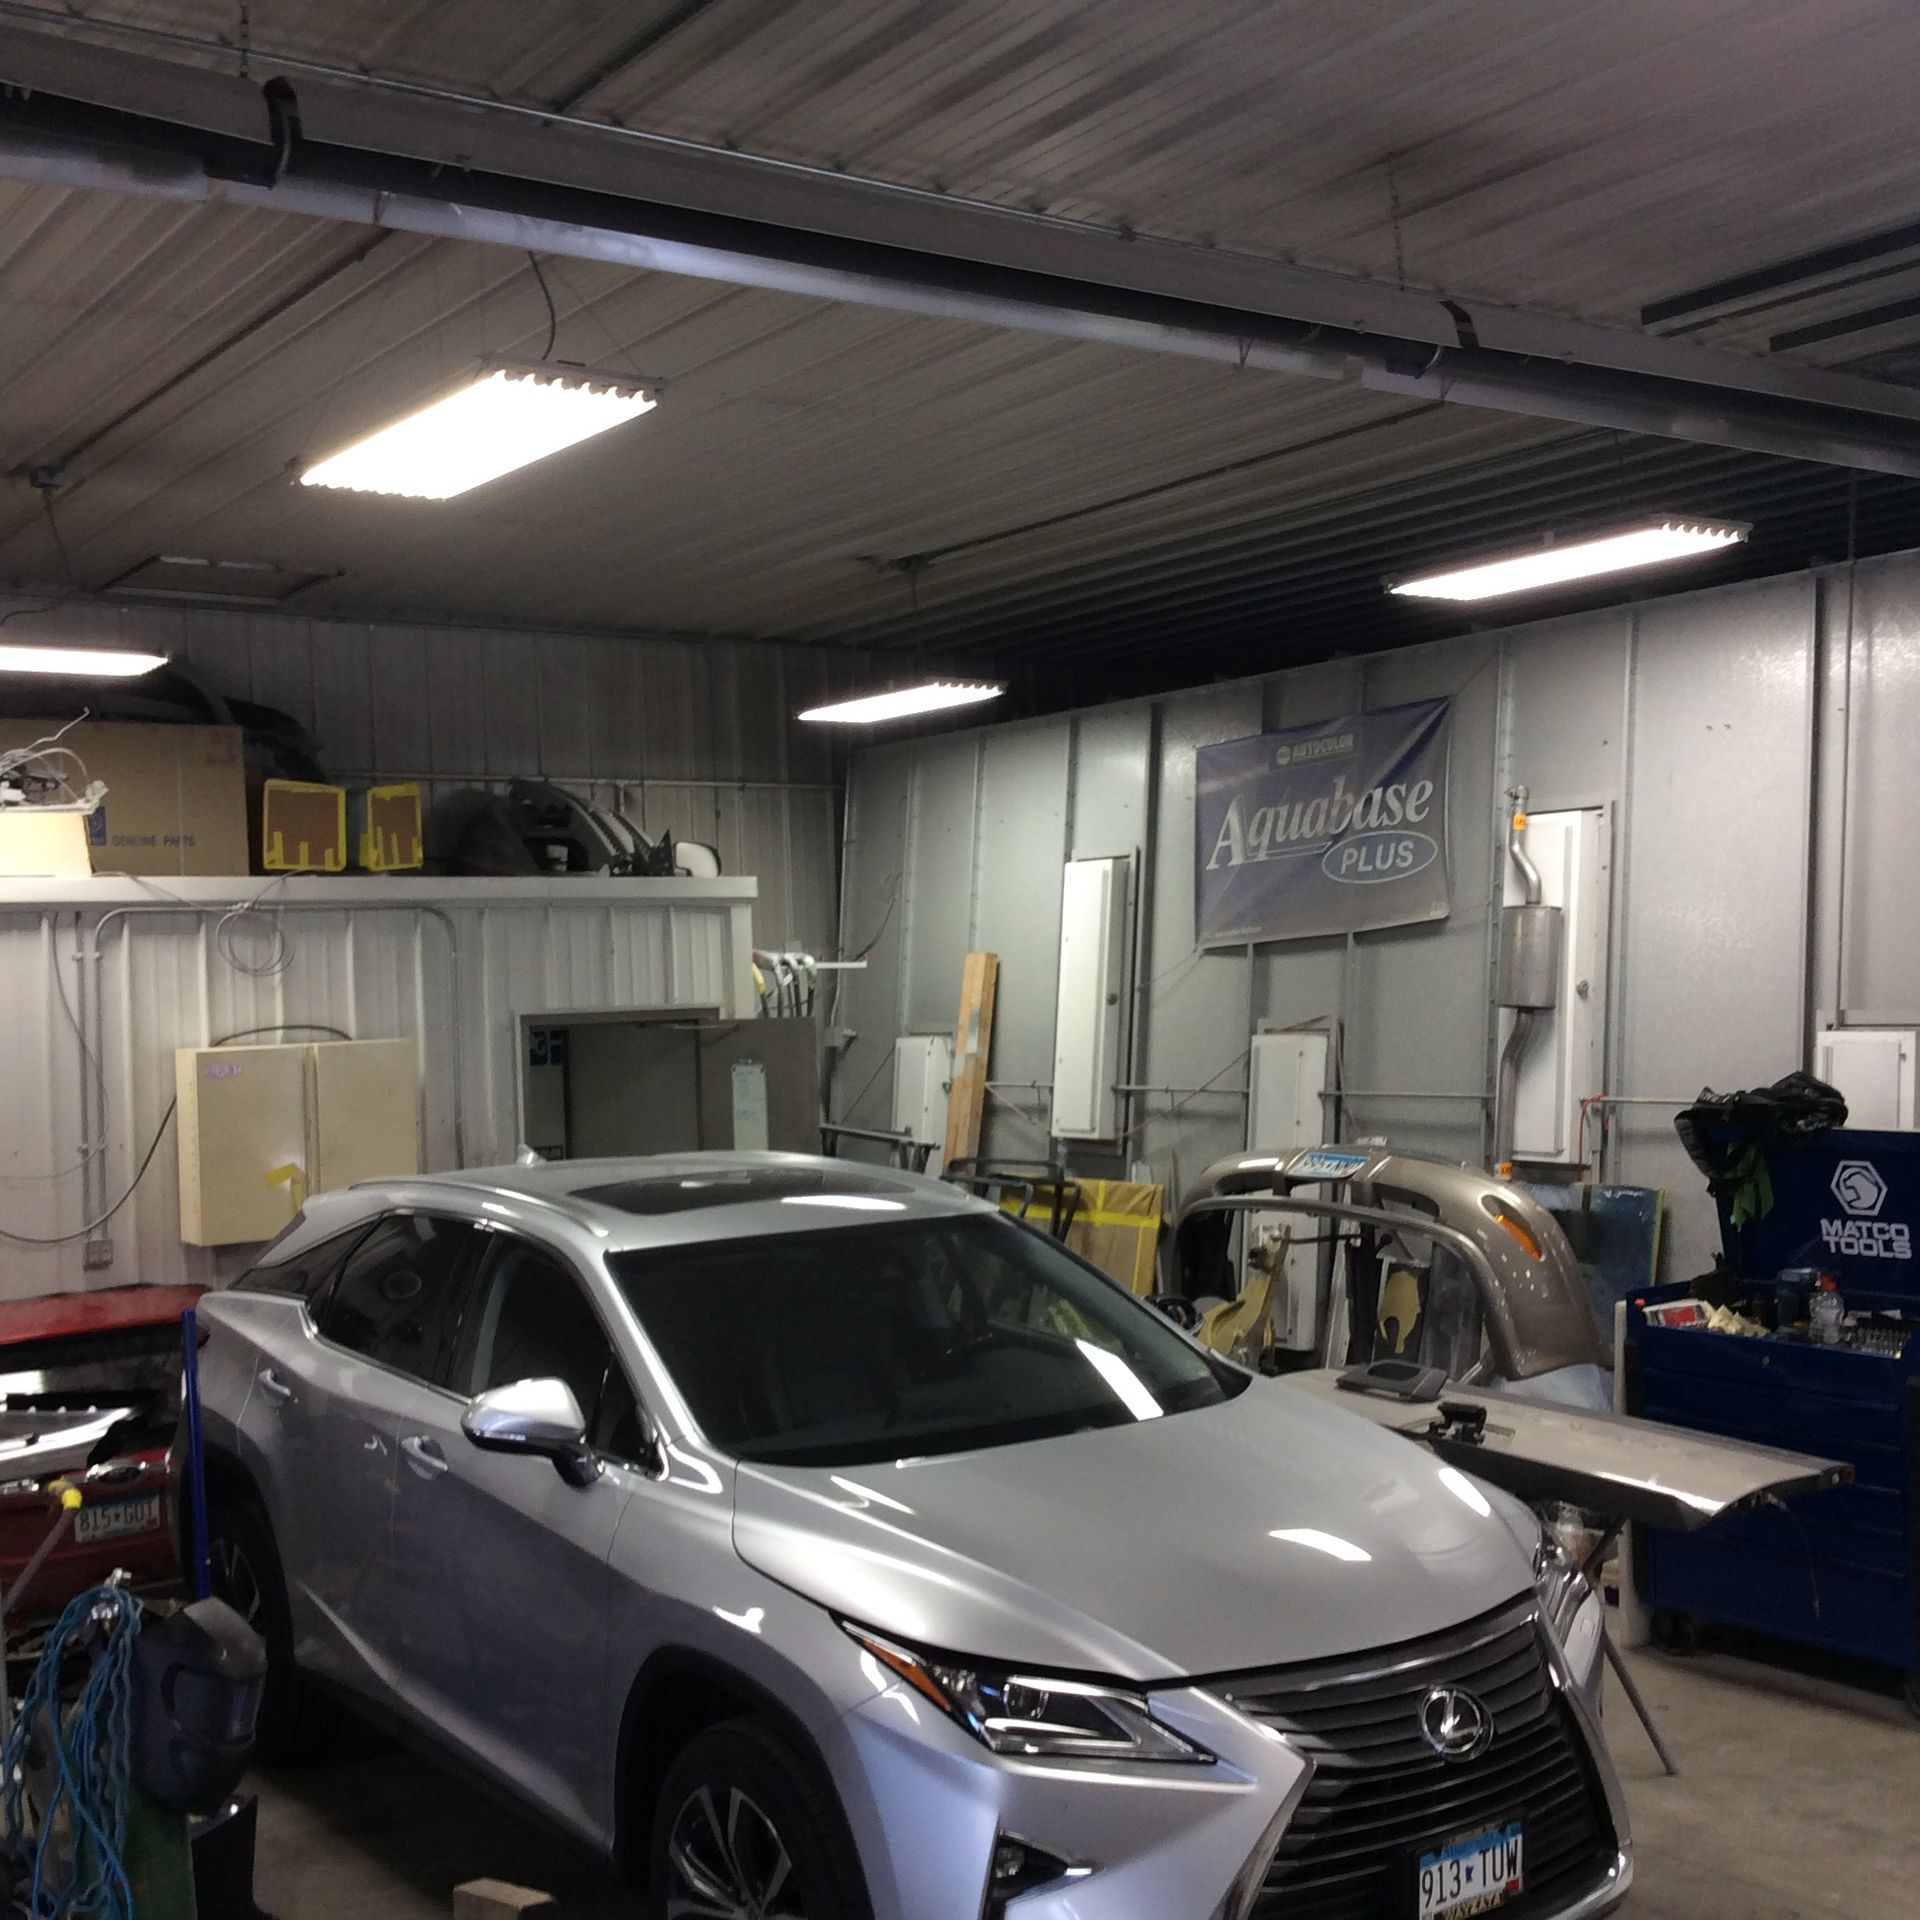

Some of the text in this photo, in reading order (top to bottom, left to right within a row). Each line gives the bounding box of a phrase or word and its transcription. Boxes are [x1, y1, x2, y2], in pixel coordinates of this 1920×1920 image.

[1206, 775, 1433, 871] Aquabase
[112, 834, 196, 848] GENUINE PARTS
[1340, 840, 1414, 875] PLUS
[1820, 1219, 1910, 1241] MATCO
[1822, 1235, 1913, 1259] TOOLS
[1421, 1859, 1462, 1909] 913
[1478, 1838, 1519, 1888] TUW
